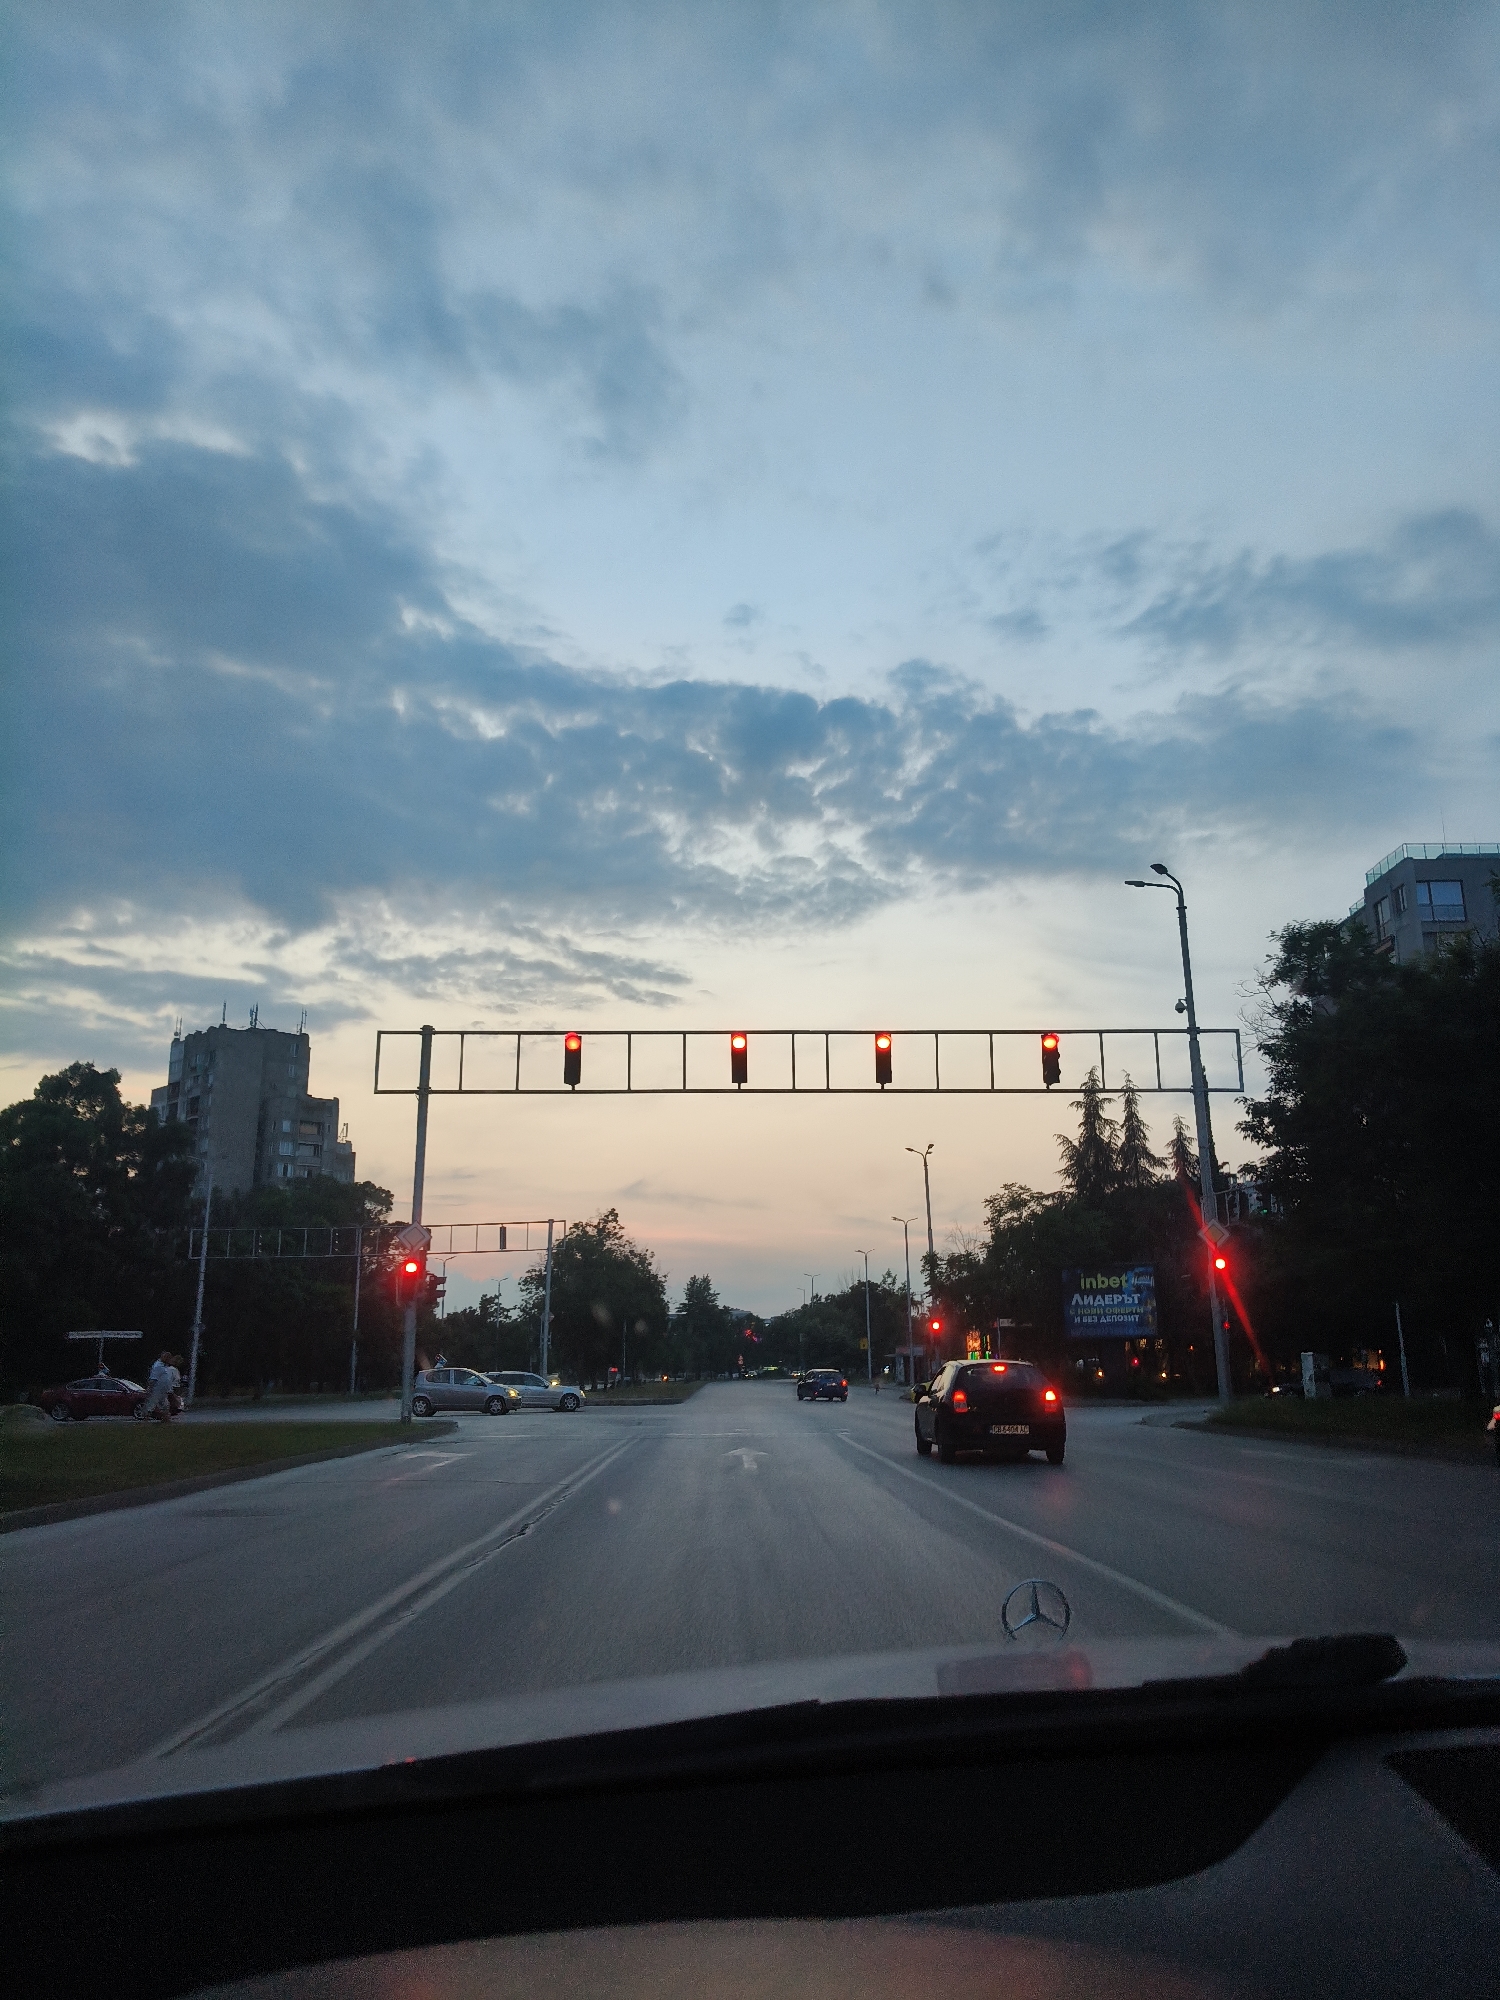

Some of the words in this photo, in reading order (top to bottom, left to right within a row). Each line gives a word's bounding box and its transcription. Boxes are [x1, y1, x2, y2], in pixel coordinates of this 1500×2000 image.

[1080, 1273, 1128, 1290] inbet
[1071, 1293, 1140, 1306] ЛИДЕРЪТ
[1100, 1314, 1140, 1323] ДЕПОЗИТ
